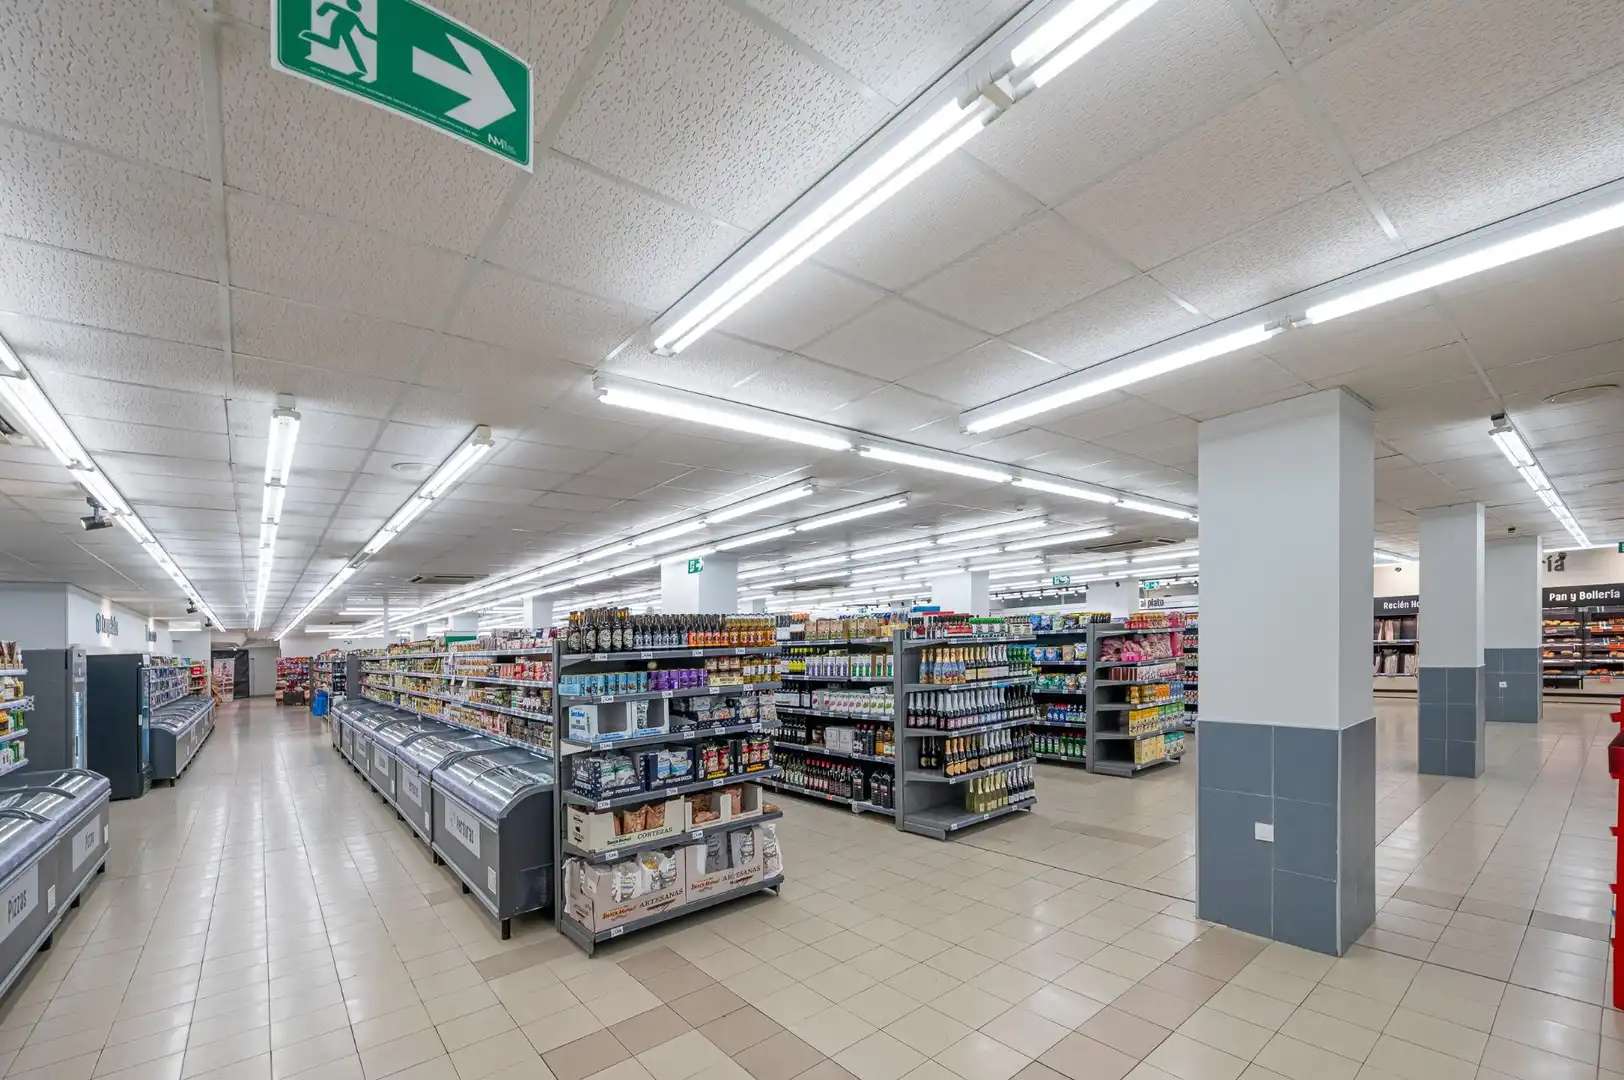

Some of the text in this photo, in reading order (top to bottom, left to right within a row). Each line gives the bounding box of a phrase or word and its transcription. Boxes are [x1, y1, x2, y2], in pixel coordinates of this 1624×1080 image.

[1549, 588, 1621, 602] Pan y Bollería
[1383, 600, 1409, 610] Recién
[637, 827, 673, 840] CORTEZAS
[722, 866, 761, 882] ARTESANAS
[639, 888, 684, 908] ARTESANAS
[8, 890, 27, 924] Pizzas
